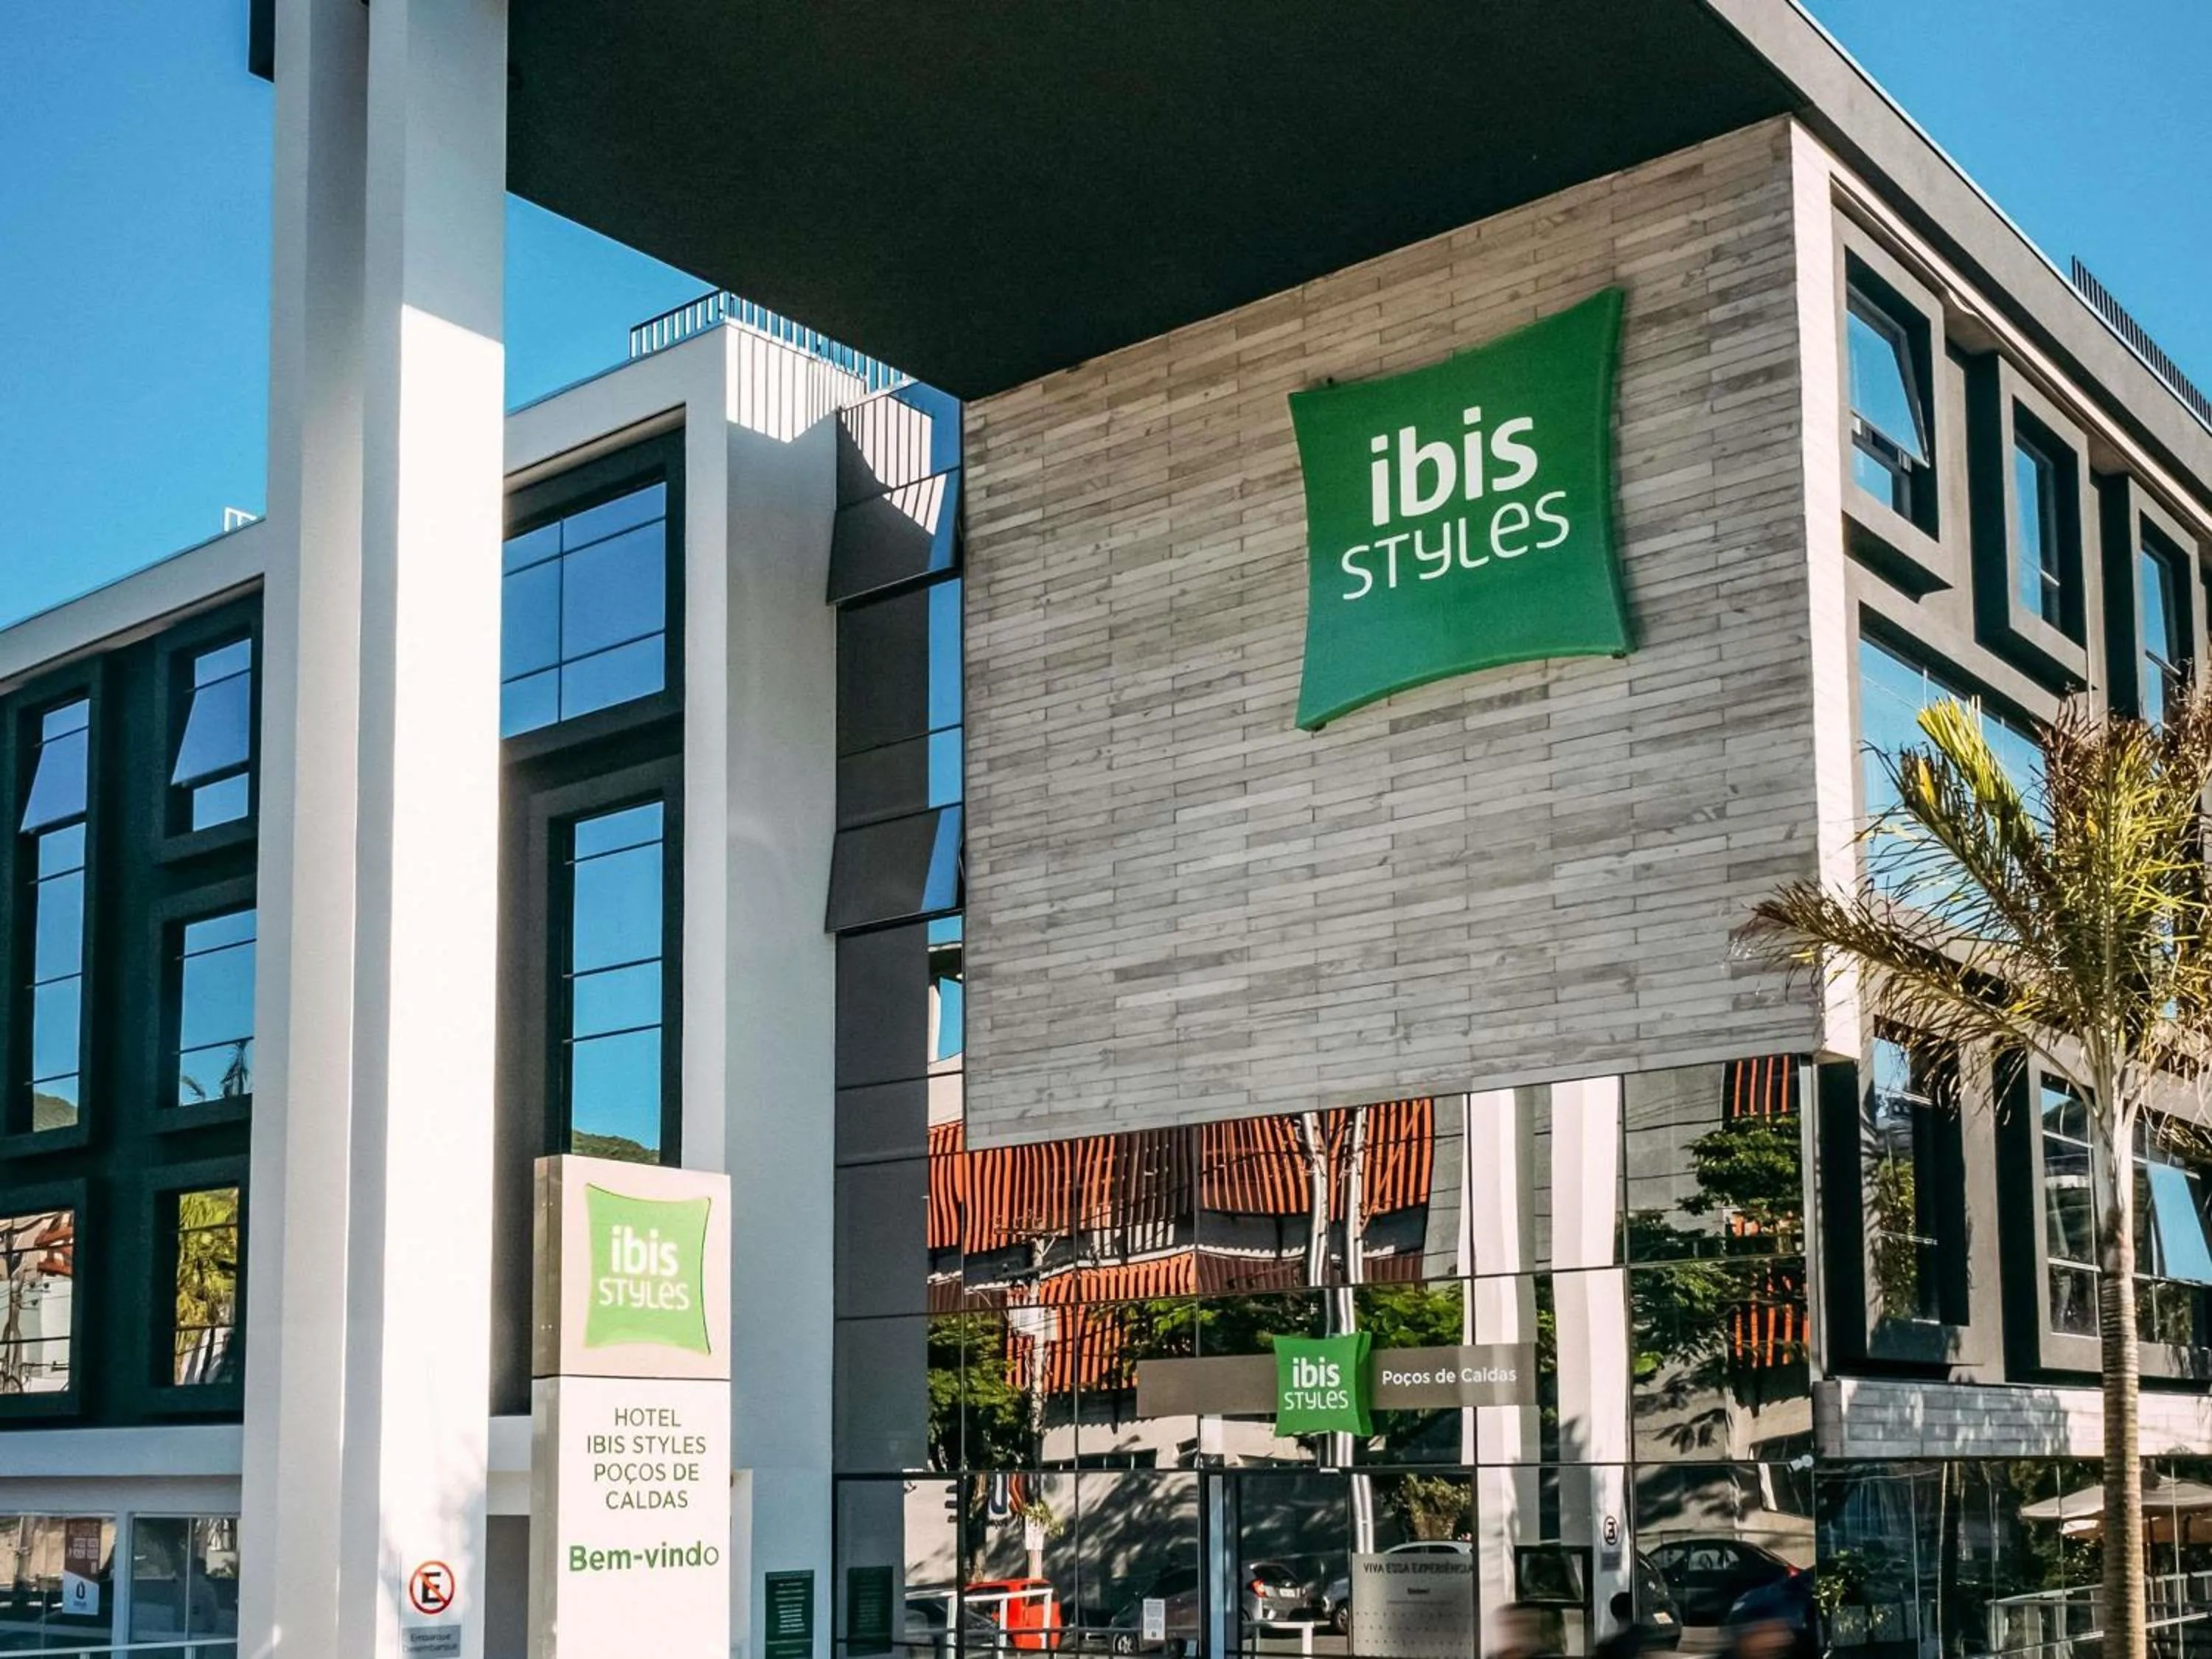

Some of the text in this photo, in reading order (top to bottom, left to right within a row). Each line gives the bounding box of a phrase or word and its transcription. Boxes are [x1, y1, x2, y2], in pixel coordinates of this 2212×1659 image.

[1371, 406, 1539, 527] ibis
[611, 1224, 679, 1277] ibis
[1292, 1357, 1340, 1388] ibis
[1382, 1367, 1517, 1387] Poços de Caldas
[614, 1408, 681, 1427] HOTEL
[587, 1435, 706, 1455] IBIS STYLES
[594, 1463, 700, 1484] POÇOS DE
[605, 1490, 689, 1509] CALDAS
[568, 1540, 720, 1572] Bem-vindo
[1364, 1562, 1383, 1574] VIVA
[421, 1571, 442, 1603] E
